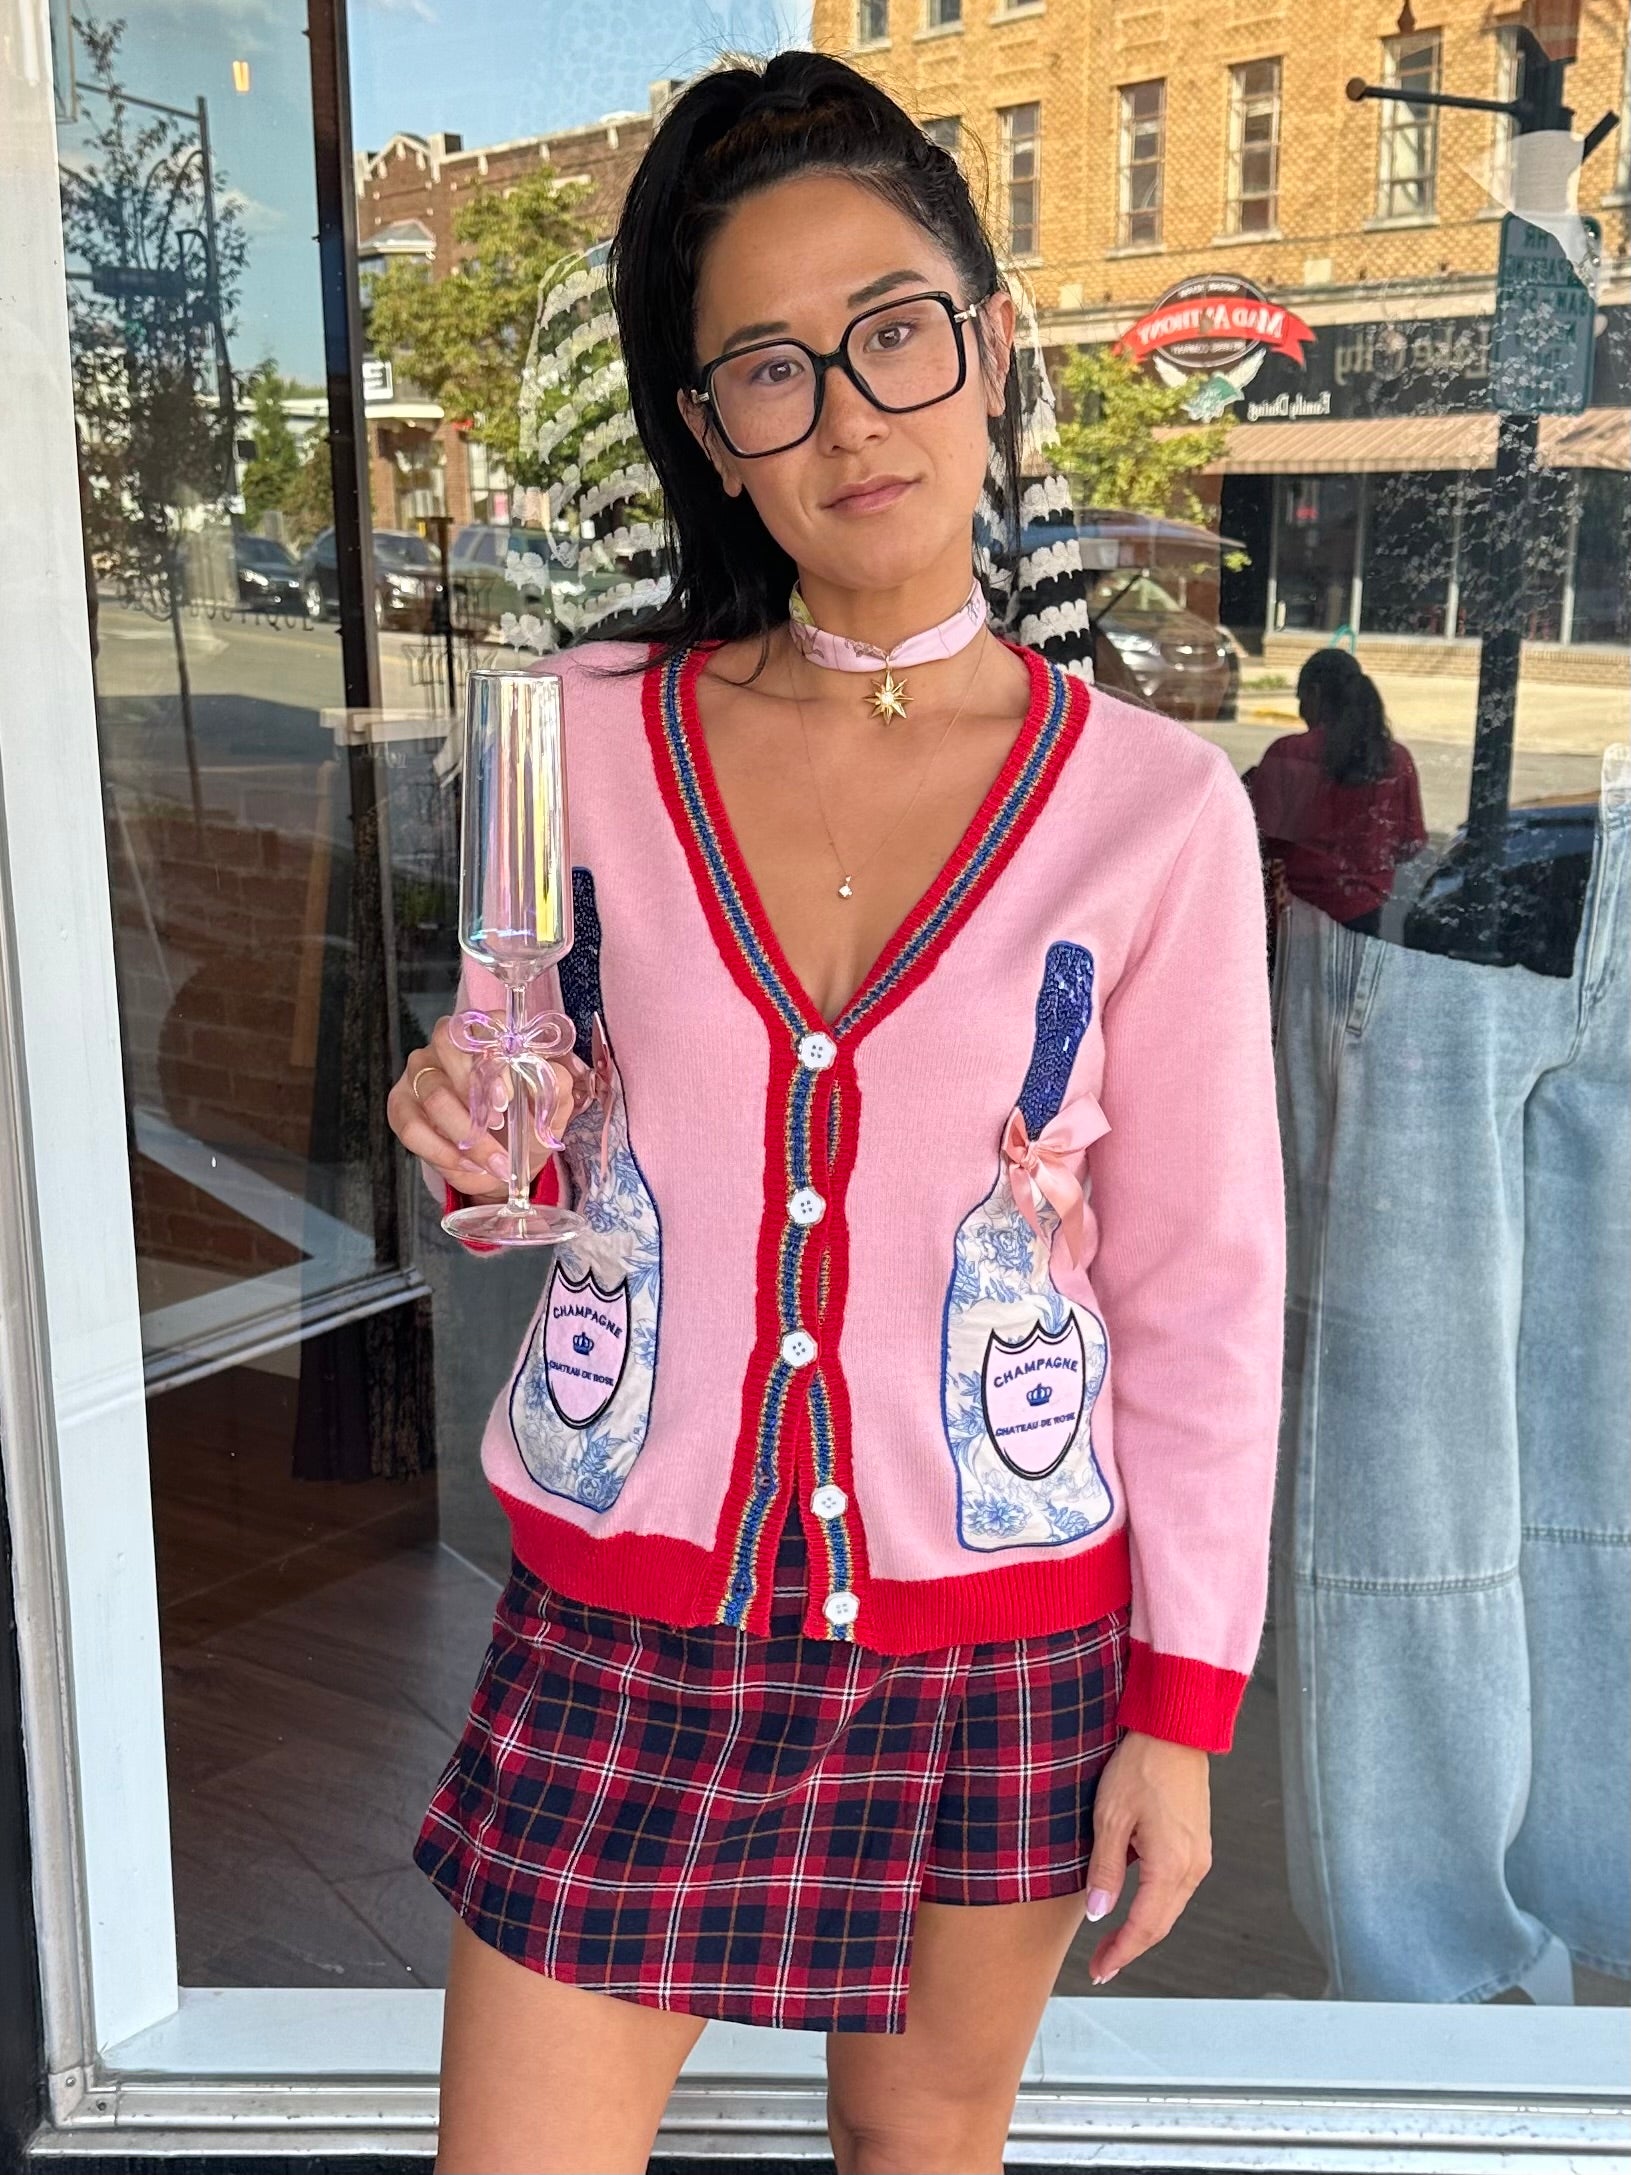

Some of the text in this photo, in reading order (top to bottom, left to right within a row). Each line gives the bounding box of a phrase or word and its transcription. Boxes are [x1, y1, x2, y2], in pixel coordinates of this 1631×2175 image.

[553, 1304, 623, 1339] CHAMPAGNE
[581, 1370, 592, 1380] DE
[993, 1356, 1078, 1388] CHAMPAGNE
[995, 1420, 1039, 1437] CHATEAU
[1041, 1418, 1052, 1428] DE
